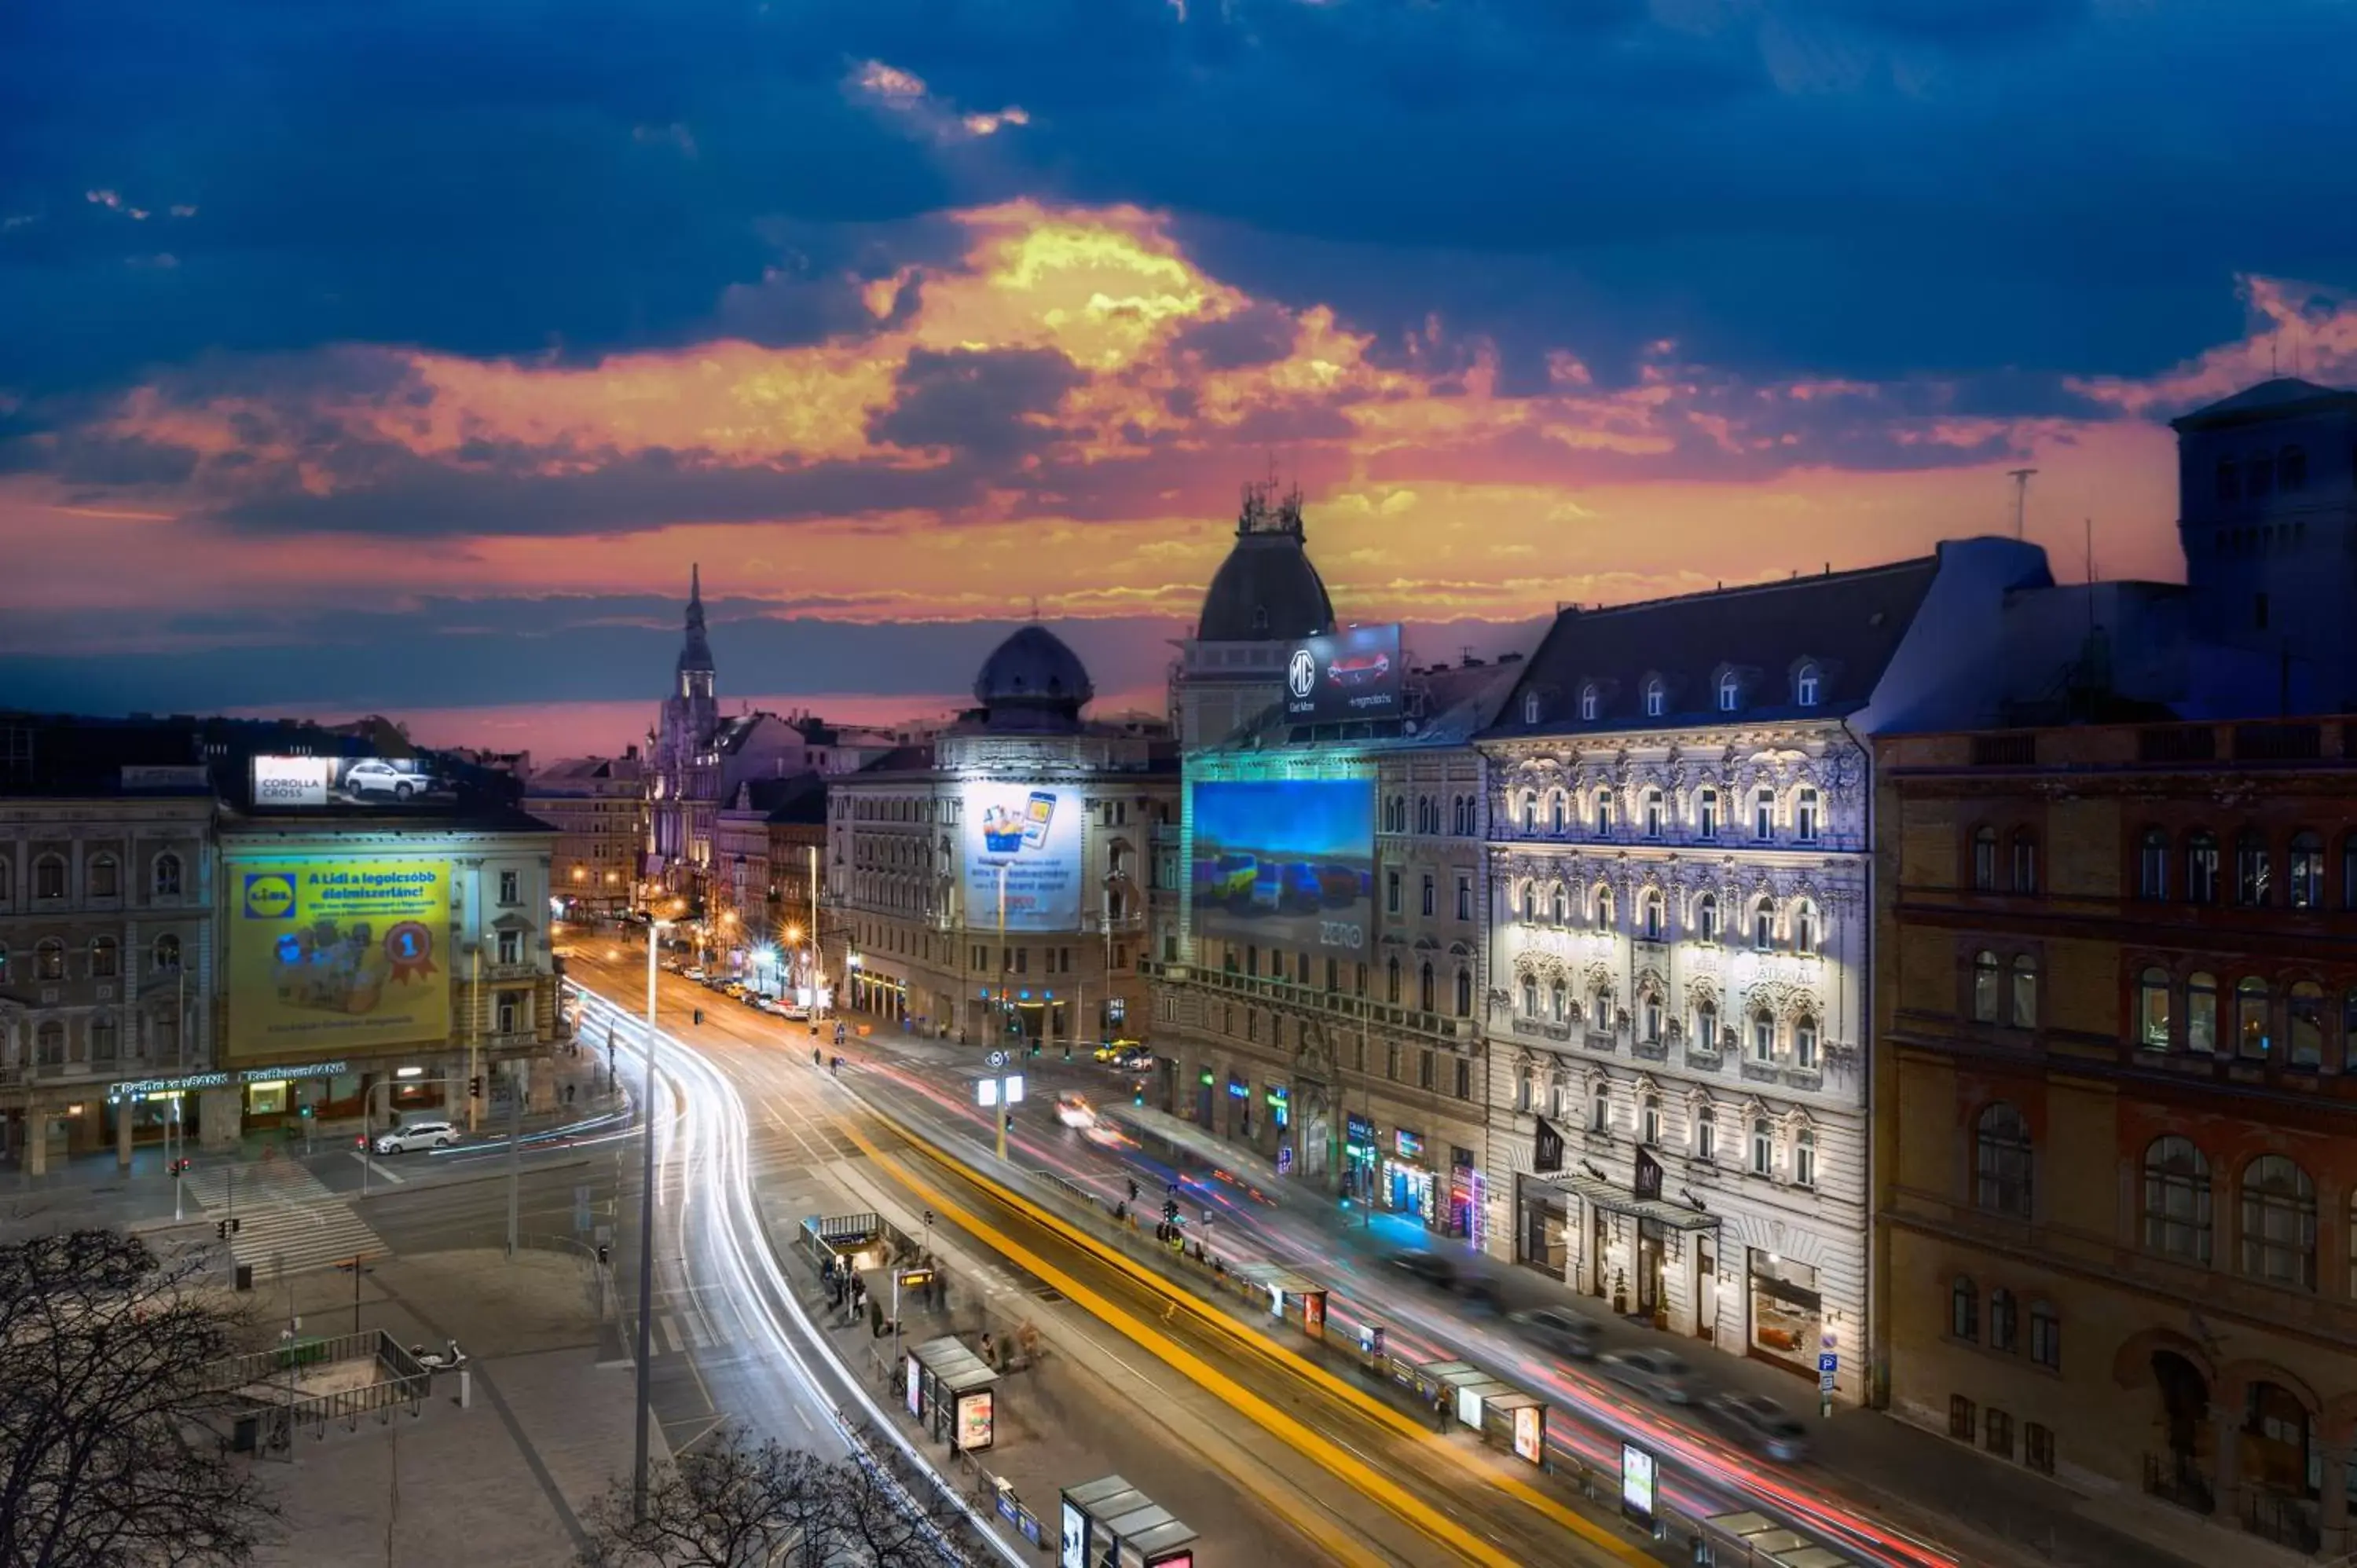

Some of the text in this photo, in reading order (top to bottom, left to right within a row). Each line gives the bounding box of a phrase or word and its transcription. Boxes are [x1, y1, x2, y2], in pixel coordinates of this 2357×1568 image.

[262, 779, 319, 788] COROLLA
[262, 788, 302, 798] CROSS
[309, 870, 436, 885] A Lidl a legolcsóbb
[1320, 921, 1363, 950] ZERO
[1348, 1121, 1373, 1137] CHANE
